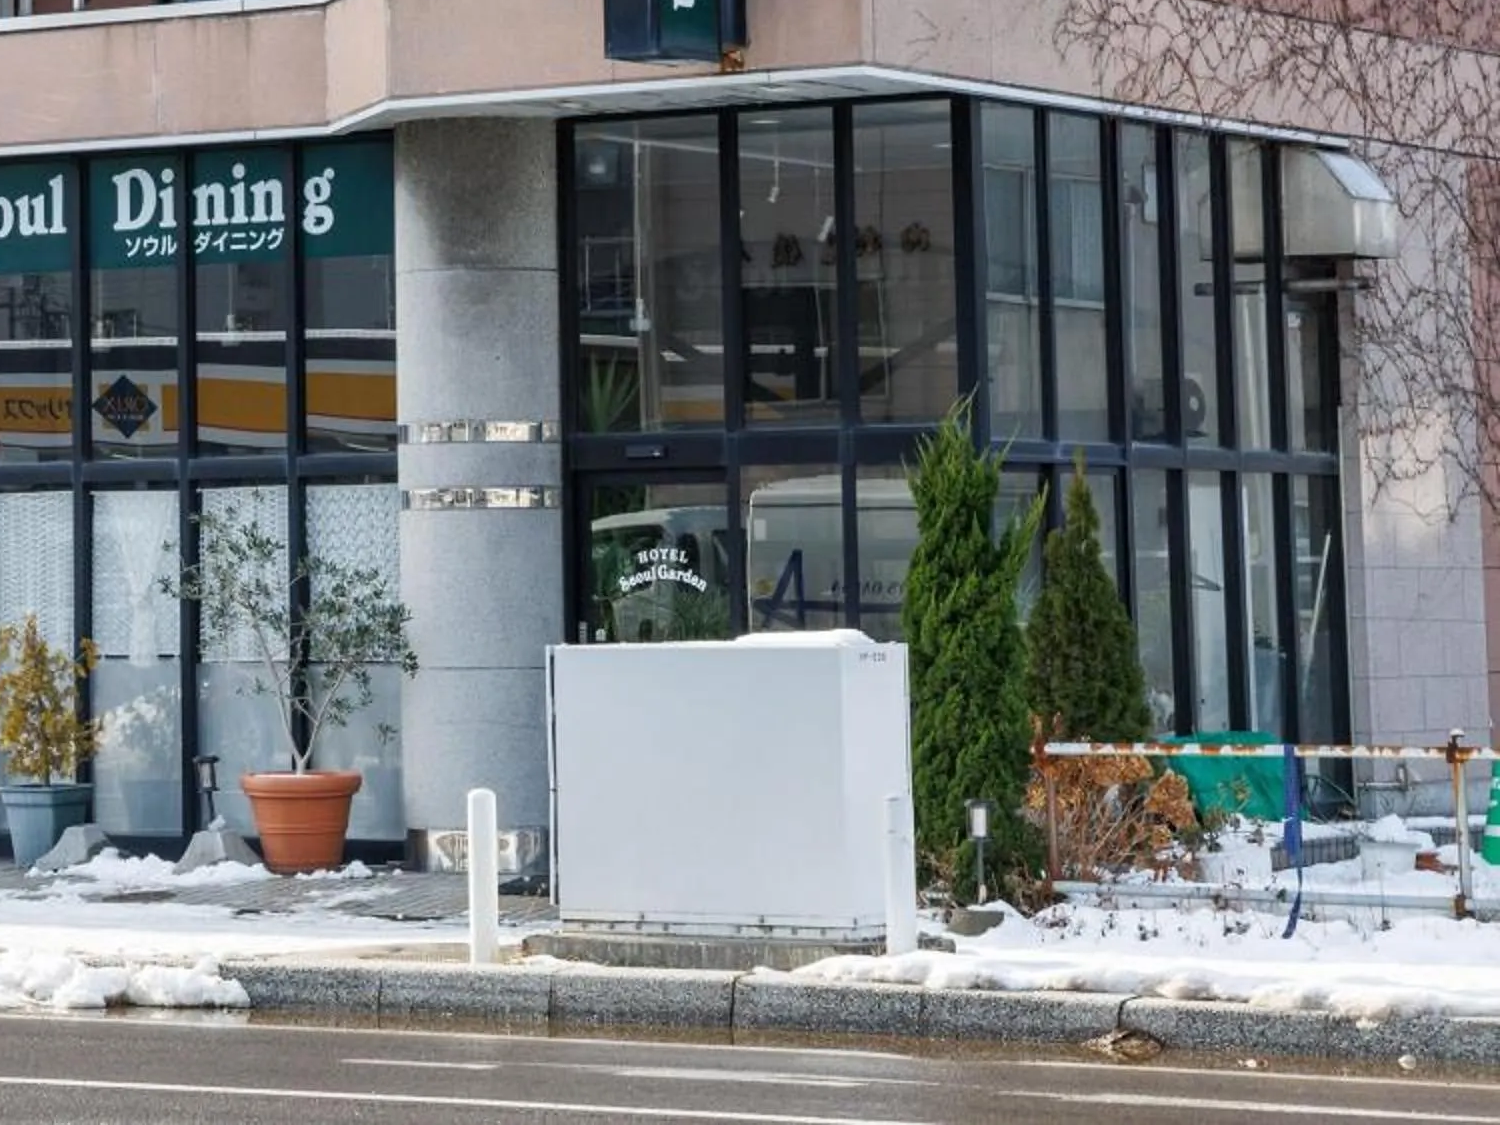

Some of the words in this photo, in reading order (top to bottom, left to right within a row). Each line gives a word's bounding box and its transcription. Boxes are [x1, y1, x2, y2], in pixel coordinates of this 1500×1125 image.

[112, 162, 336, 236] Dining
[125, 233, 178, 258] ソウル
[194, 227, 285, 254] ダイニング
[638, 548, 689, 564] HOTEL
[619, 565, 657, 592] Seoul
[658, 564, 707, 592] Garden
